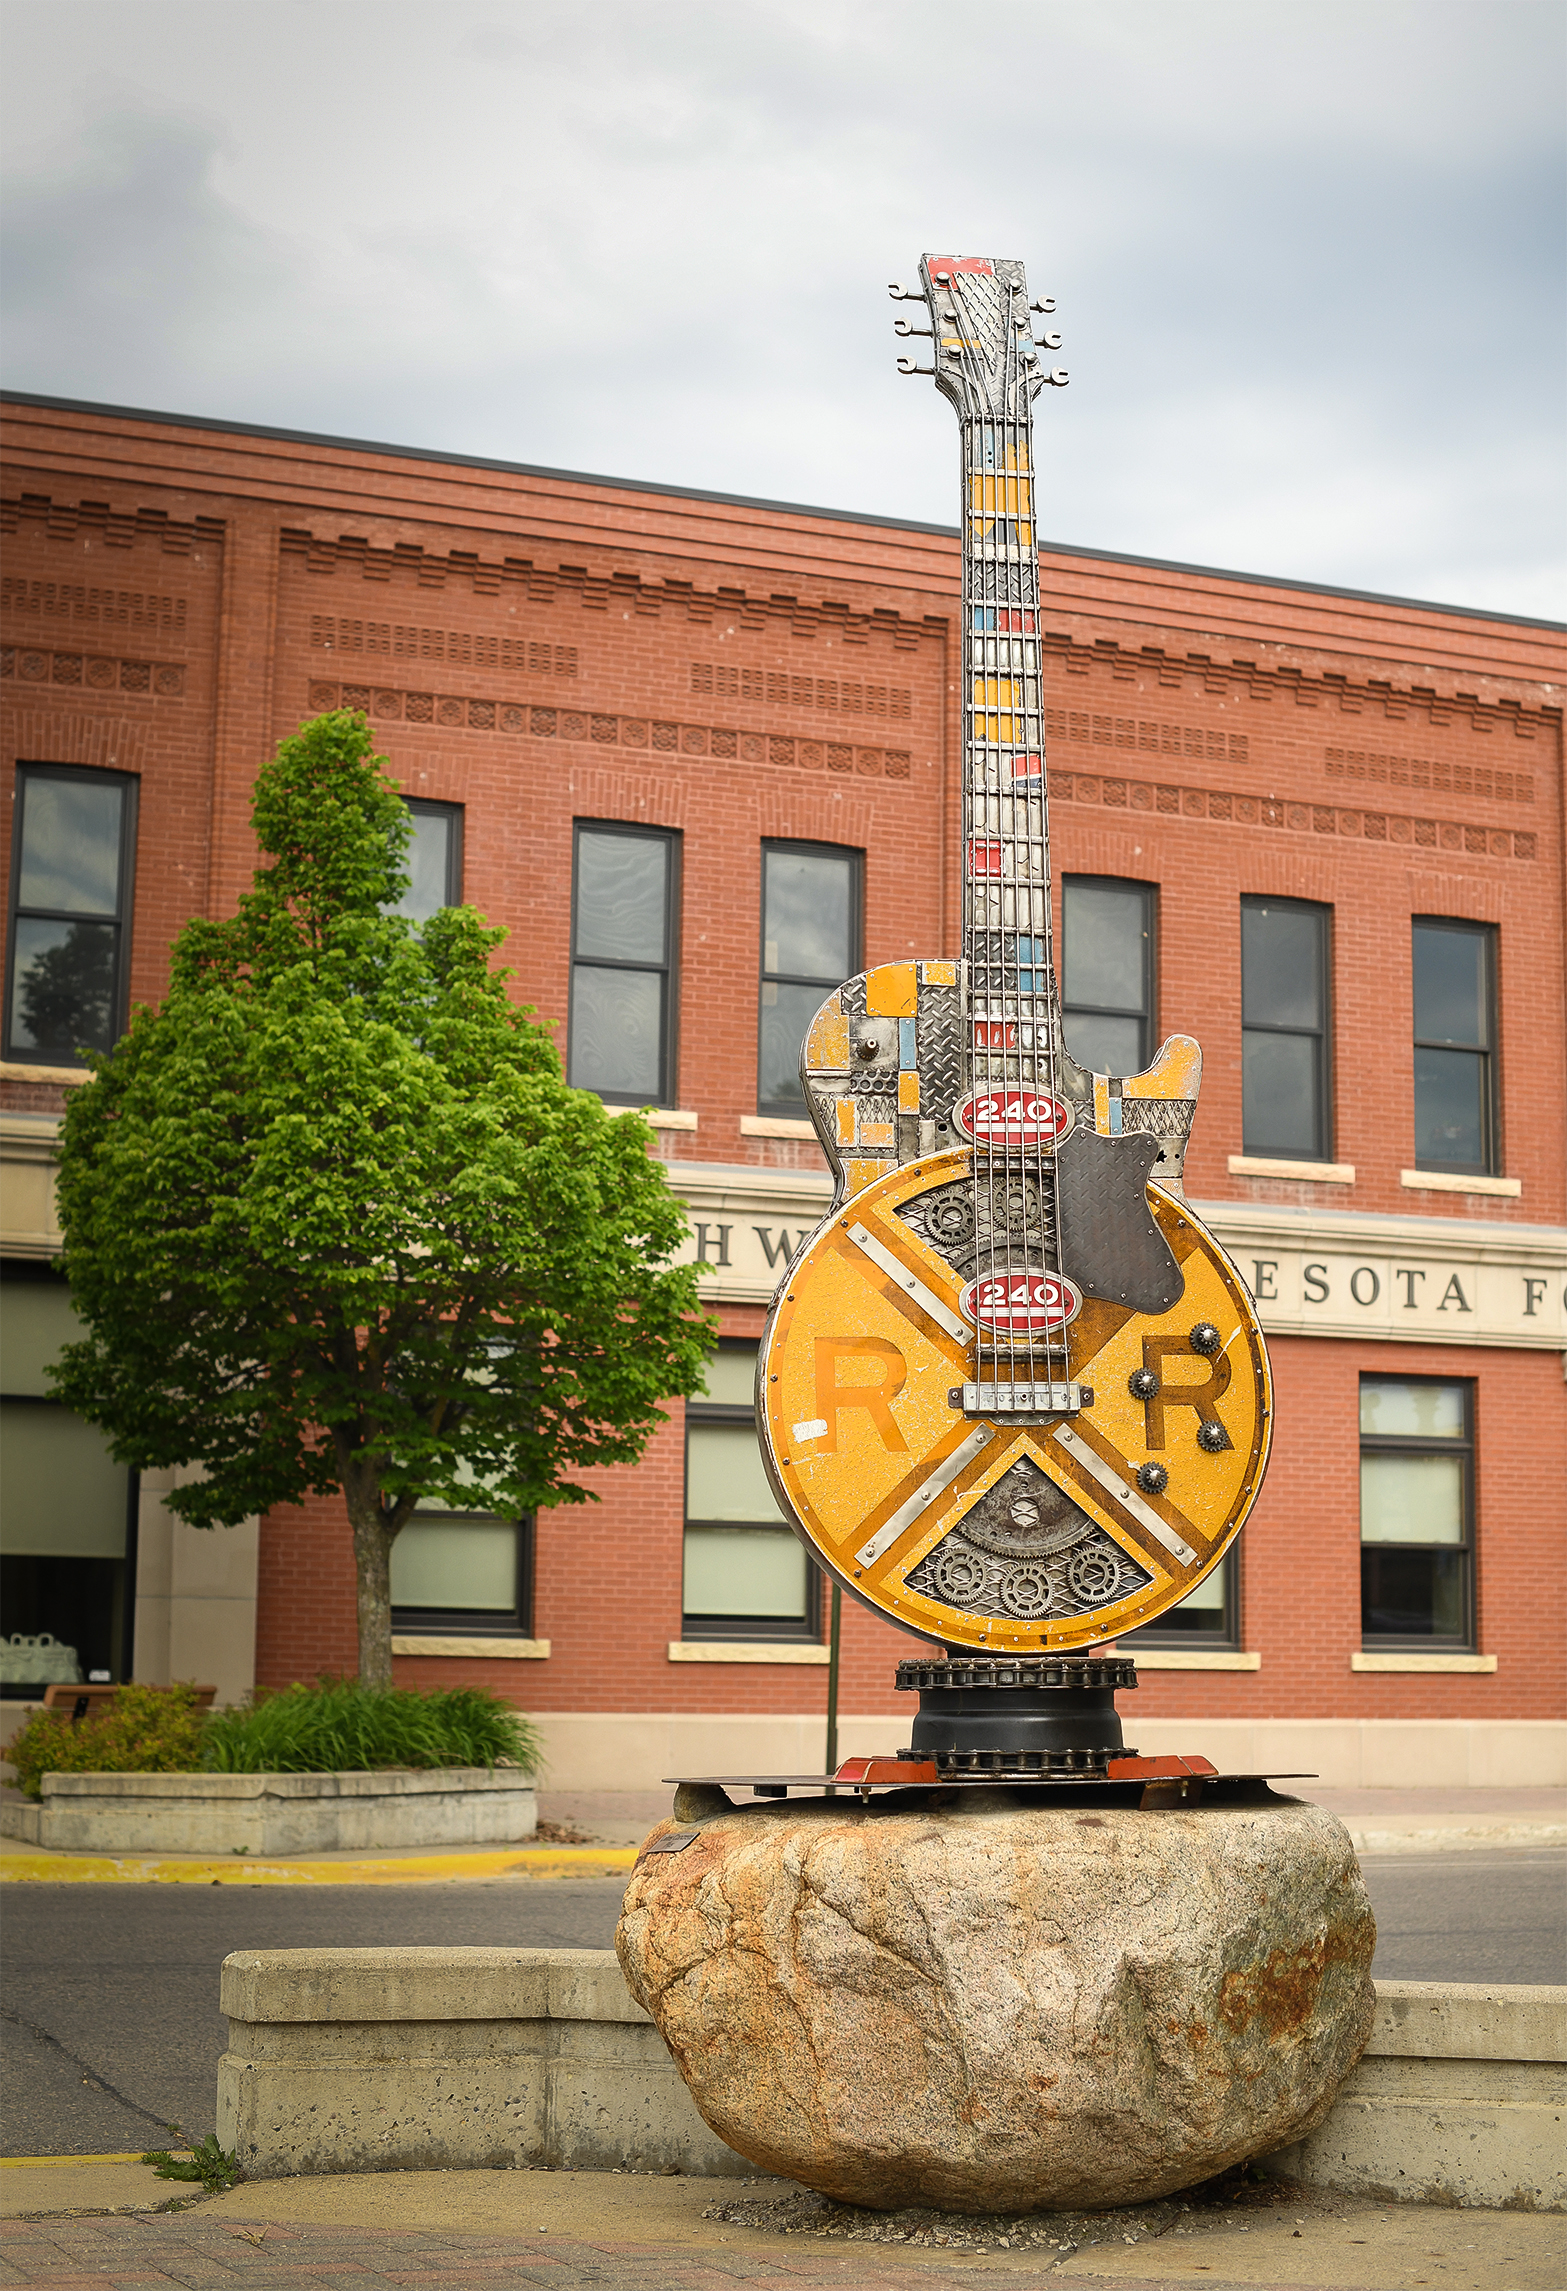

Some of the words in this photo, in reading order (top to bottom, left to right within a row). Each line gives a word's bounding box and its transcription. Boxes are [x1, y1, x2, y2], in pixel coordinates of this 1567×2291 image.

[977, 1100, 1052, 1121] 240
[983, 1284, 1059, 1305] 240
[1252, 1260, 1473, 1312] ESOTA
[1522, 1277, 1567, 1316] F
[814, 1336, 911, 1452] R
[1141, 1335, 1235, 1450] R
